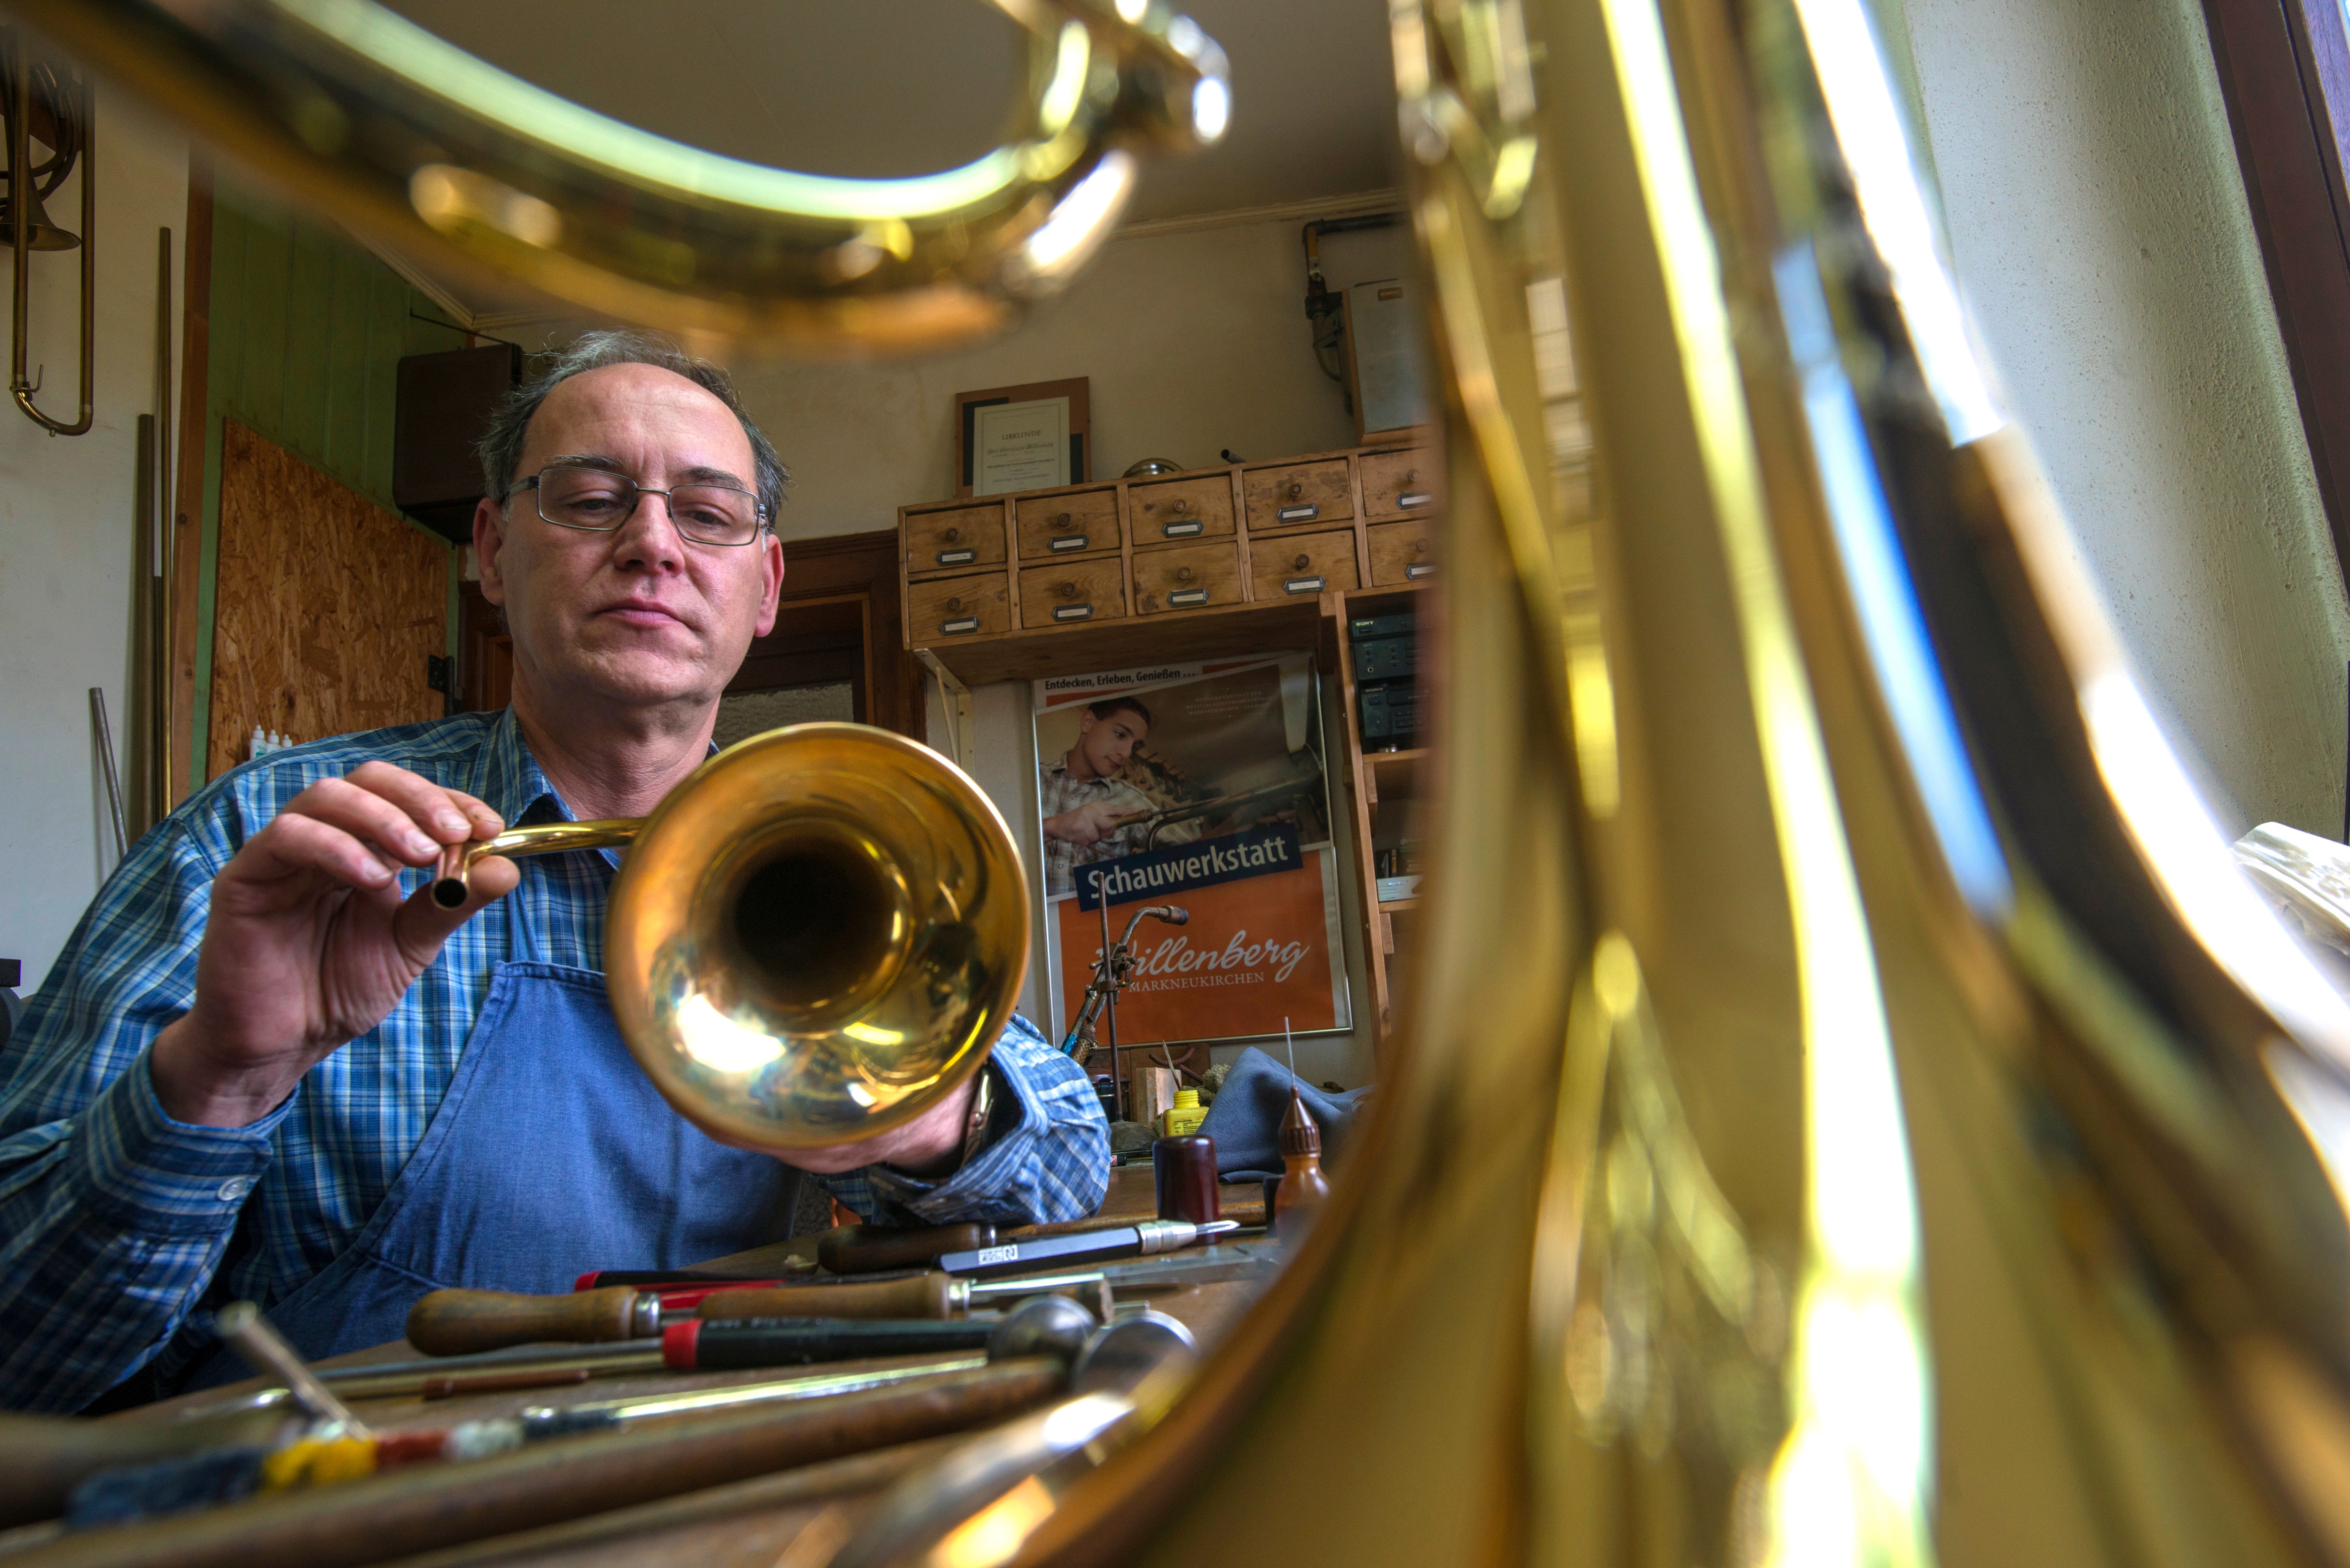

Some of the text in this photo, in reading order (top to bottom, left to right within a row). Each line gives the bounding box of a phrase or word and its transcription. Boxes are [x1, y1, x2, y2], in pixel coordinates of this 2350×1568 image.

[1002, 429, 1042, 440] URKUNDE
[1045, 678, 1095, 690] Entdecken,
[1097, 674, 1134, 686] Erleben,
[1136, 669, 1181, 681] Genießen
[1088, 836, 1288, 899] Schauwerkstatt
[1128, 972, 1265, 993] MARKNEUKIRCHEN
